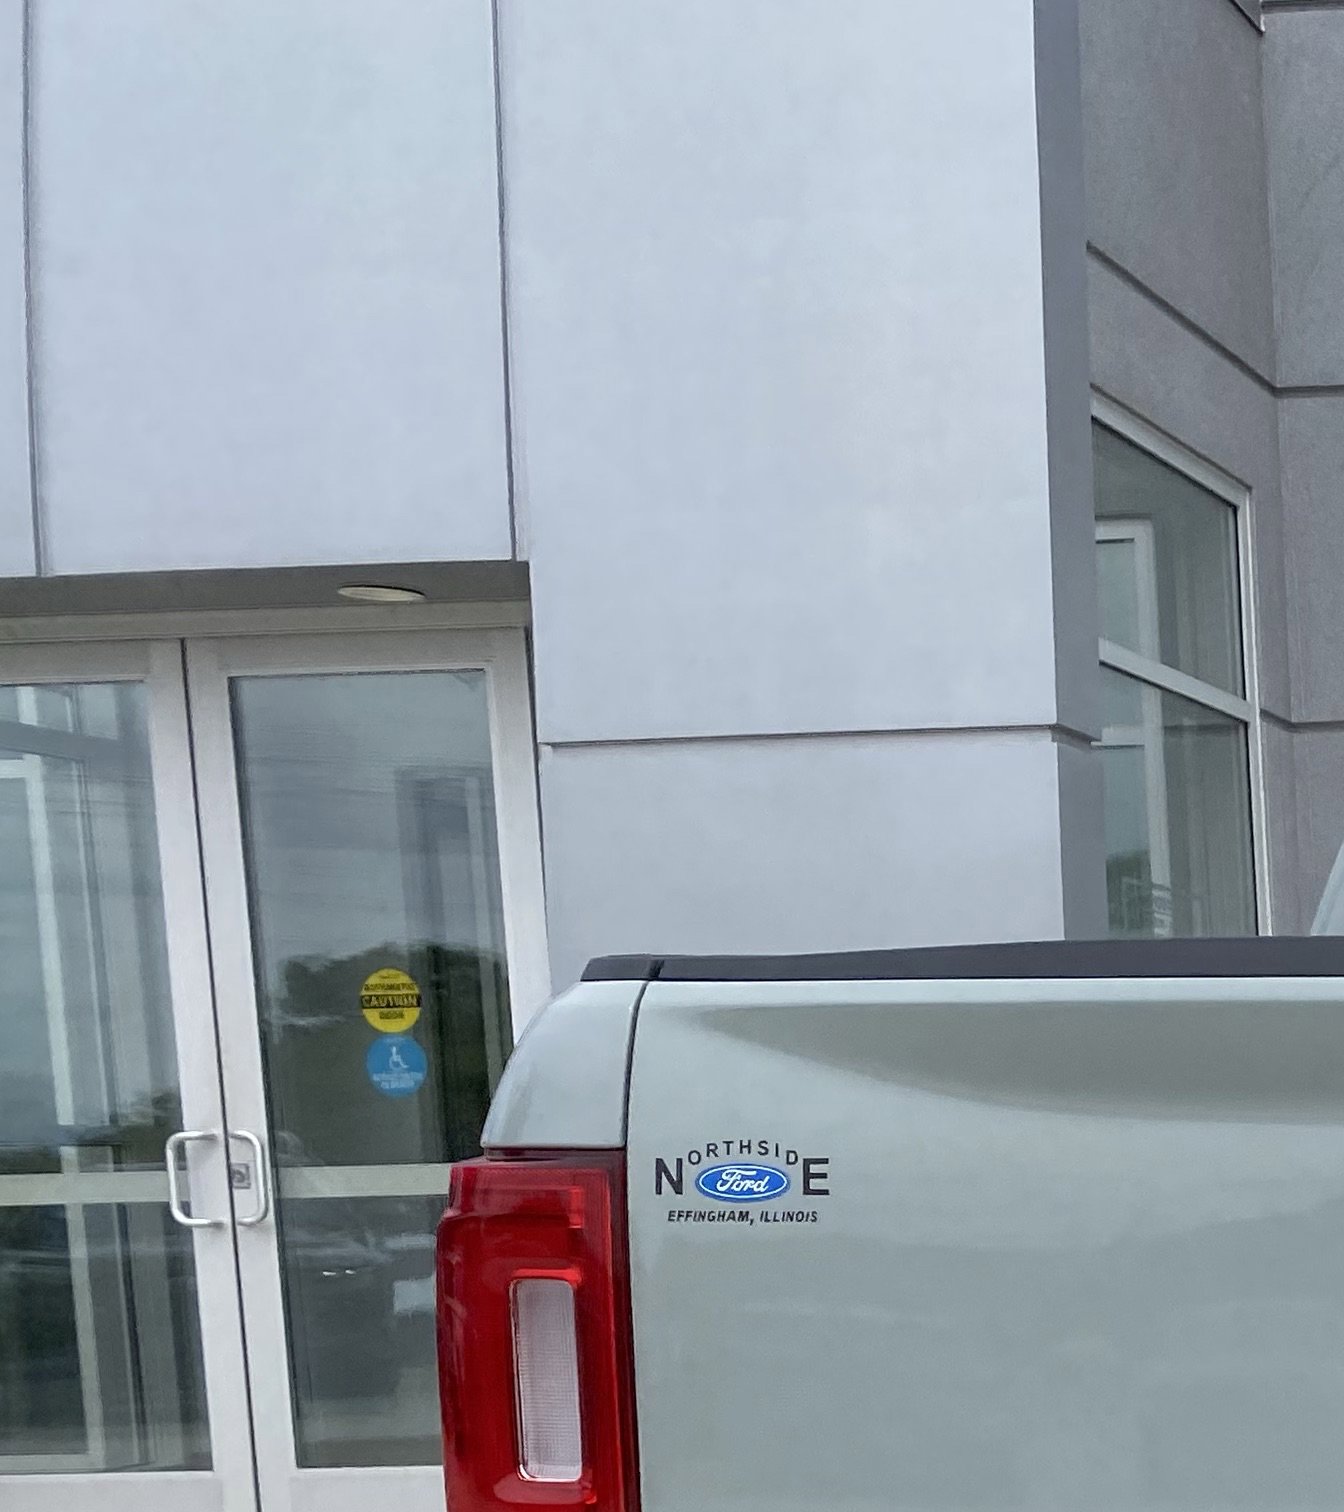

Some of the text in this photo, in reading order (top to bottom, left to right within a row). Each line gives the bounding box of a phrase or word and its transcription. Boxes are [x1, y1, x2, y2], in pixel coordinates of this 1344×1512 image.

[655, 1139, 830, 1196] NORTHSIDE
[716, 1168, 770, 1193] Ford
[667, 1209, 818, 1226] EFFINGHAM, ILLINOIS
